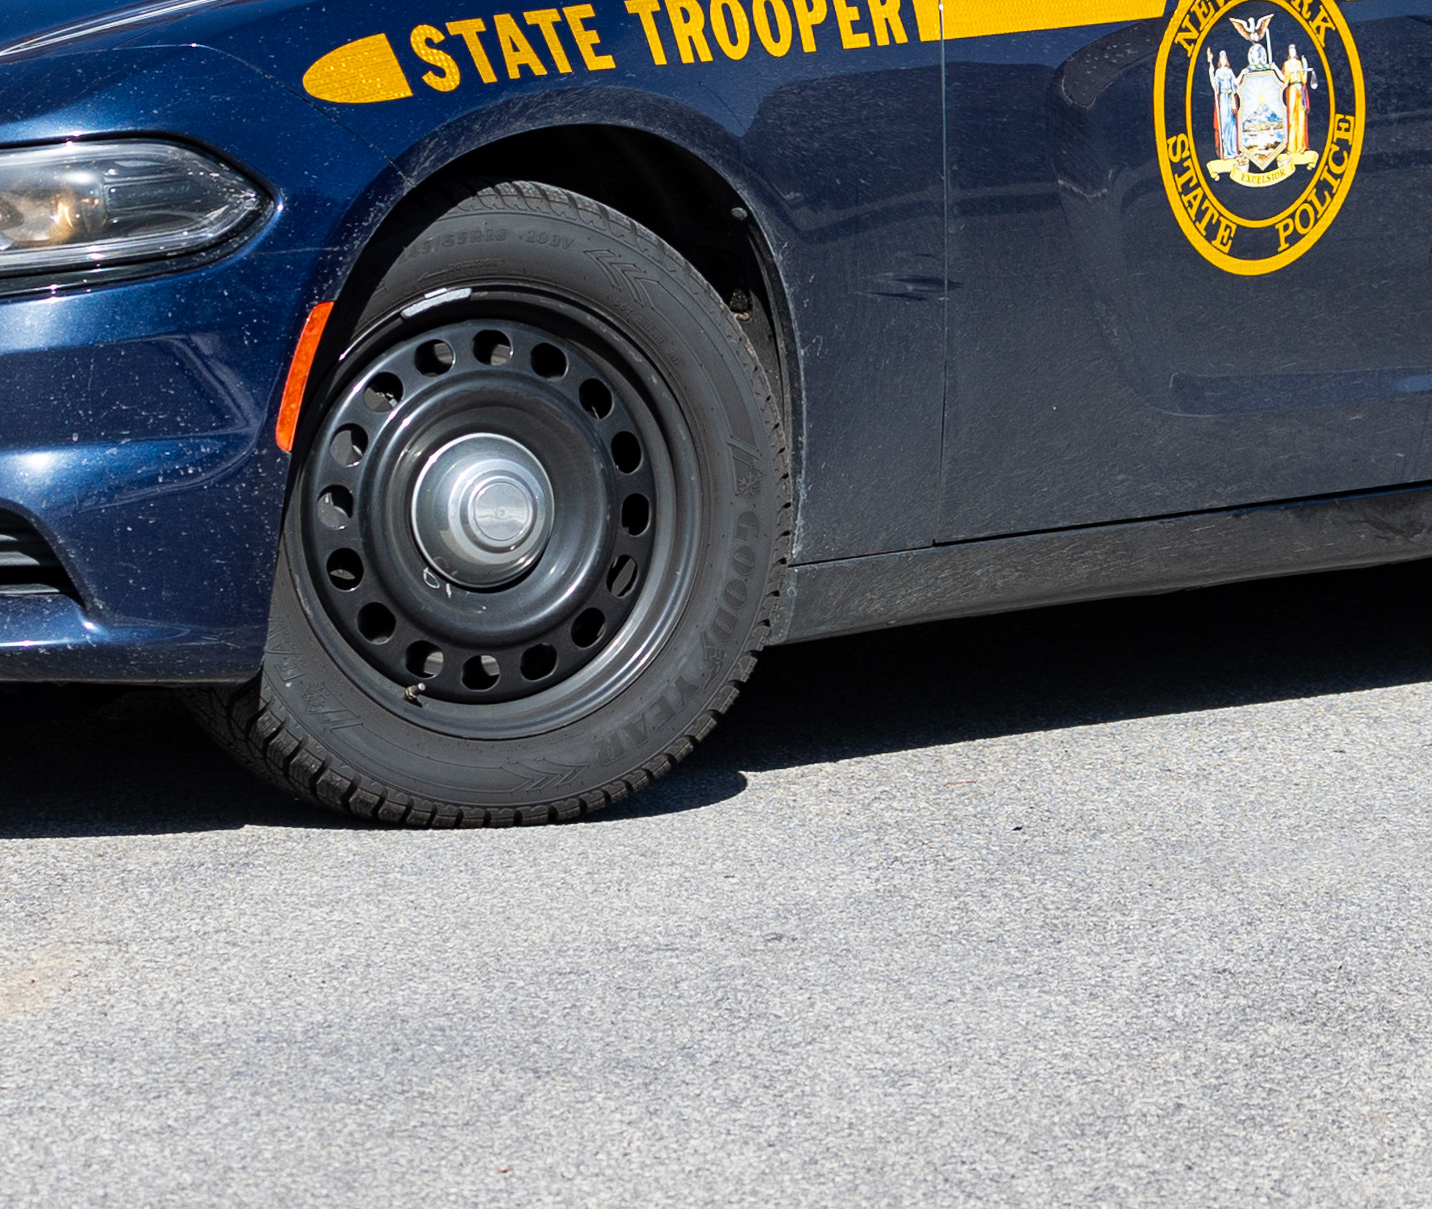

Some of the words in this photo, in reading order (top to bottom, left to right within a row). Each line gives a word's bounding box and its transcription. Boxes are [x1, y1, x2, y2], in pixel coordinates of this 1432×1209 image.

[410, 3, 616, 92] STATE
[1167, 132, 1236, 254] STATE
[1275, 114, 1355, 252] POLICE
[1240, 168, 1286, 185] EXCELSIOR
[595, 510, 760, 767] GOODYEAR
